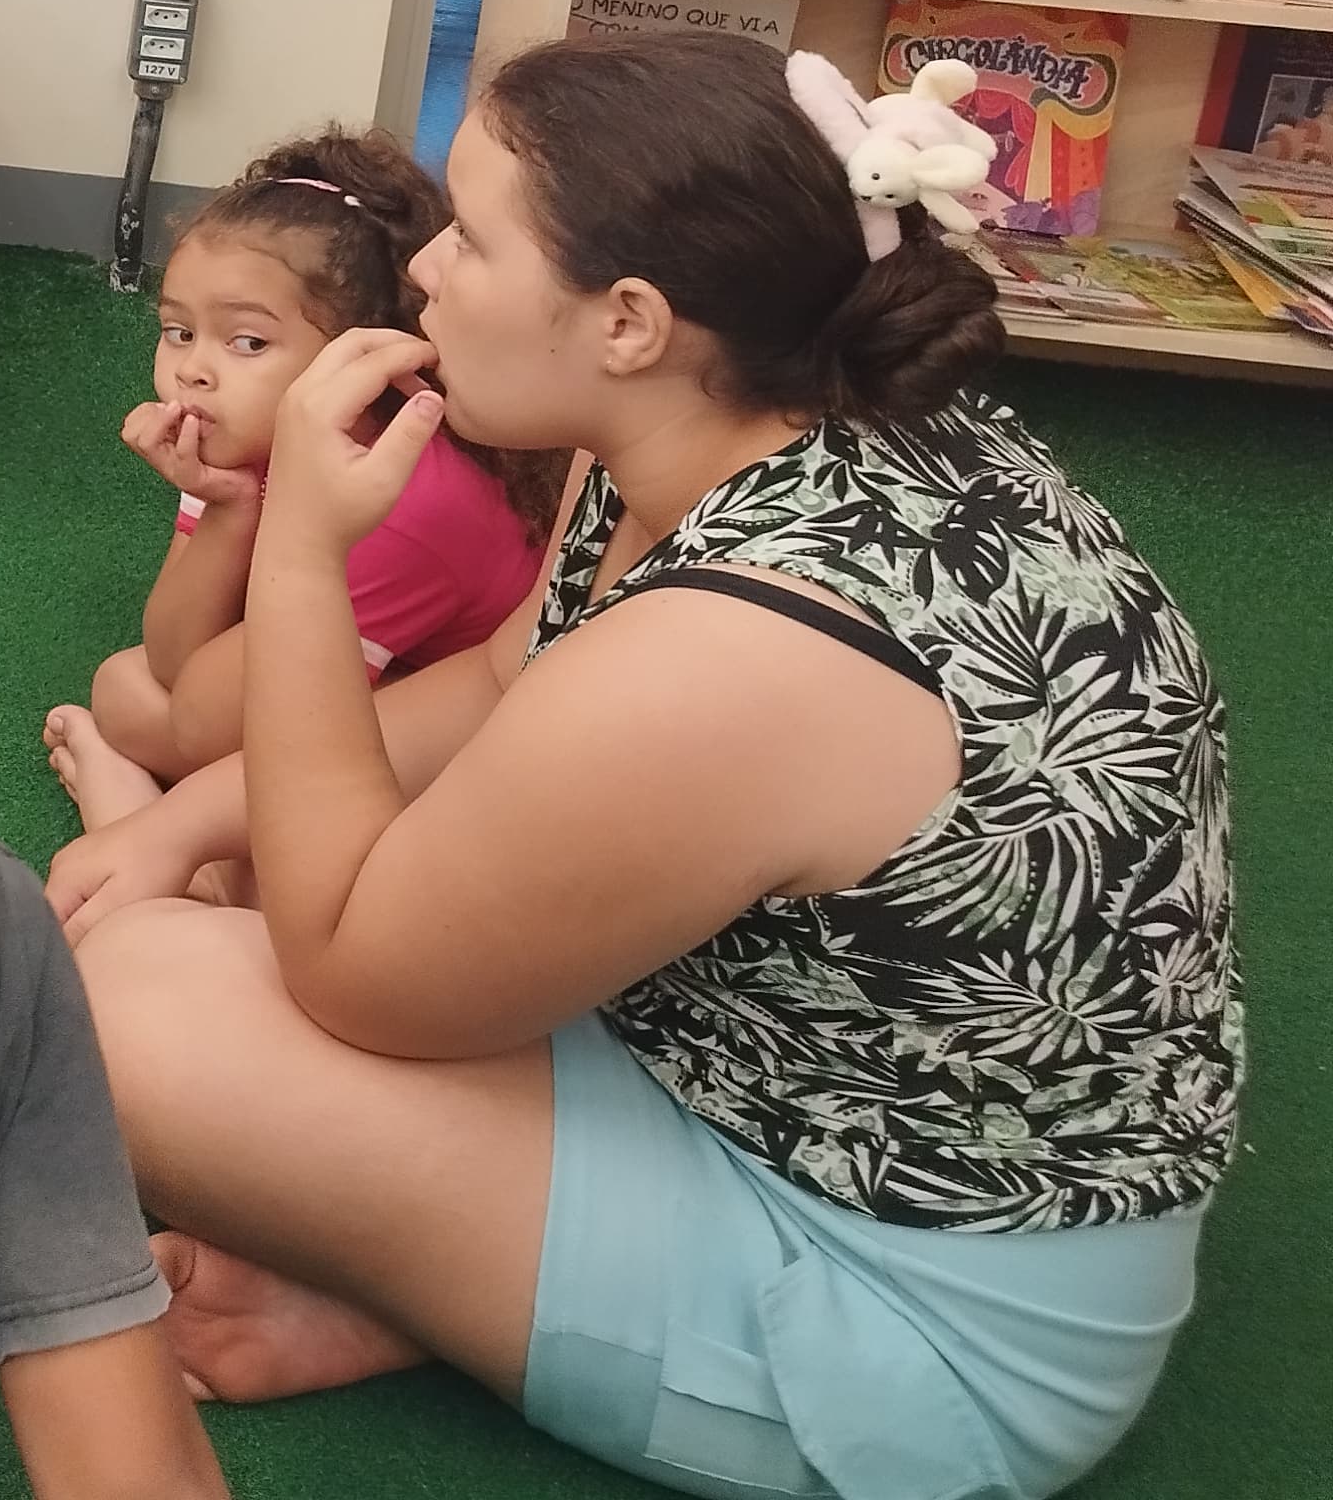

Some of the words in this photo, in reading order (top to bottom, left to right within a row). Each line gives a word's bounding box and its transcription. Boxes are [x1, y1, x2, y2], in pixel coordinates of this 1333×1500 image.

[686, 8, 730, 29] QUE
[739, 15, 781, 36] VIA
[145, 64, 164, 76] 127
[168, 67, 176, 77] V
